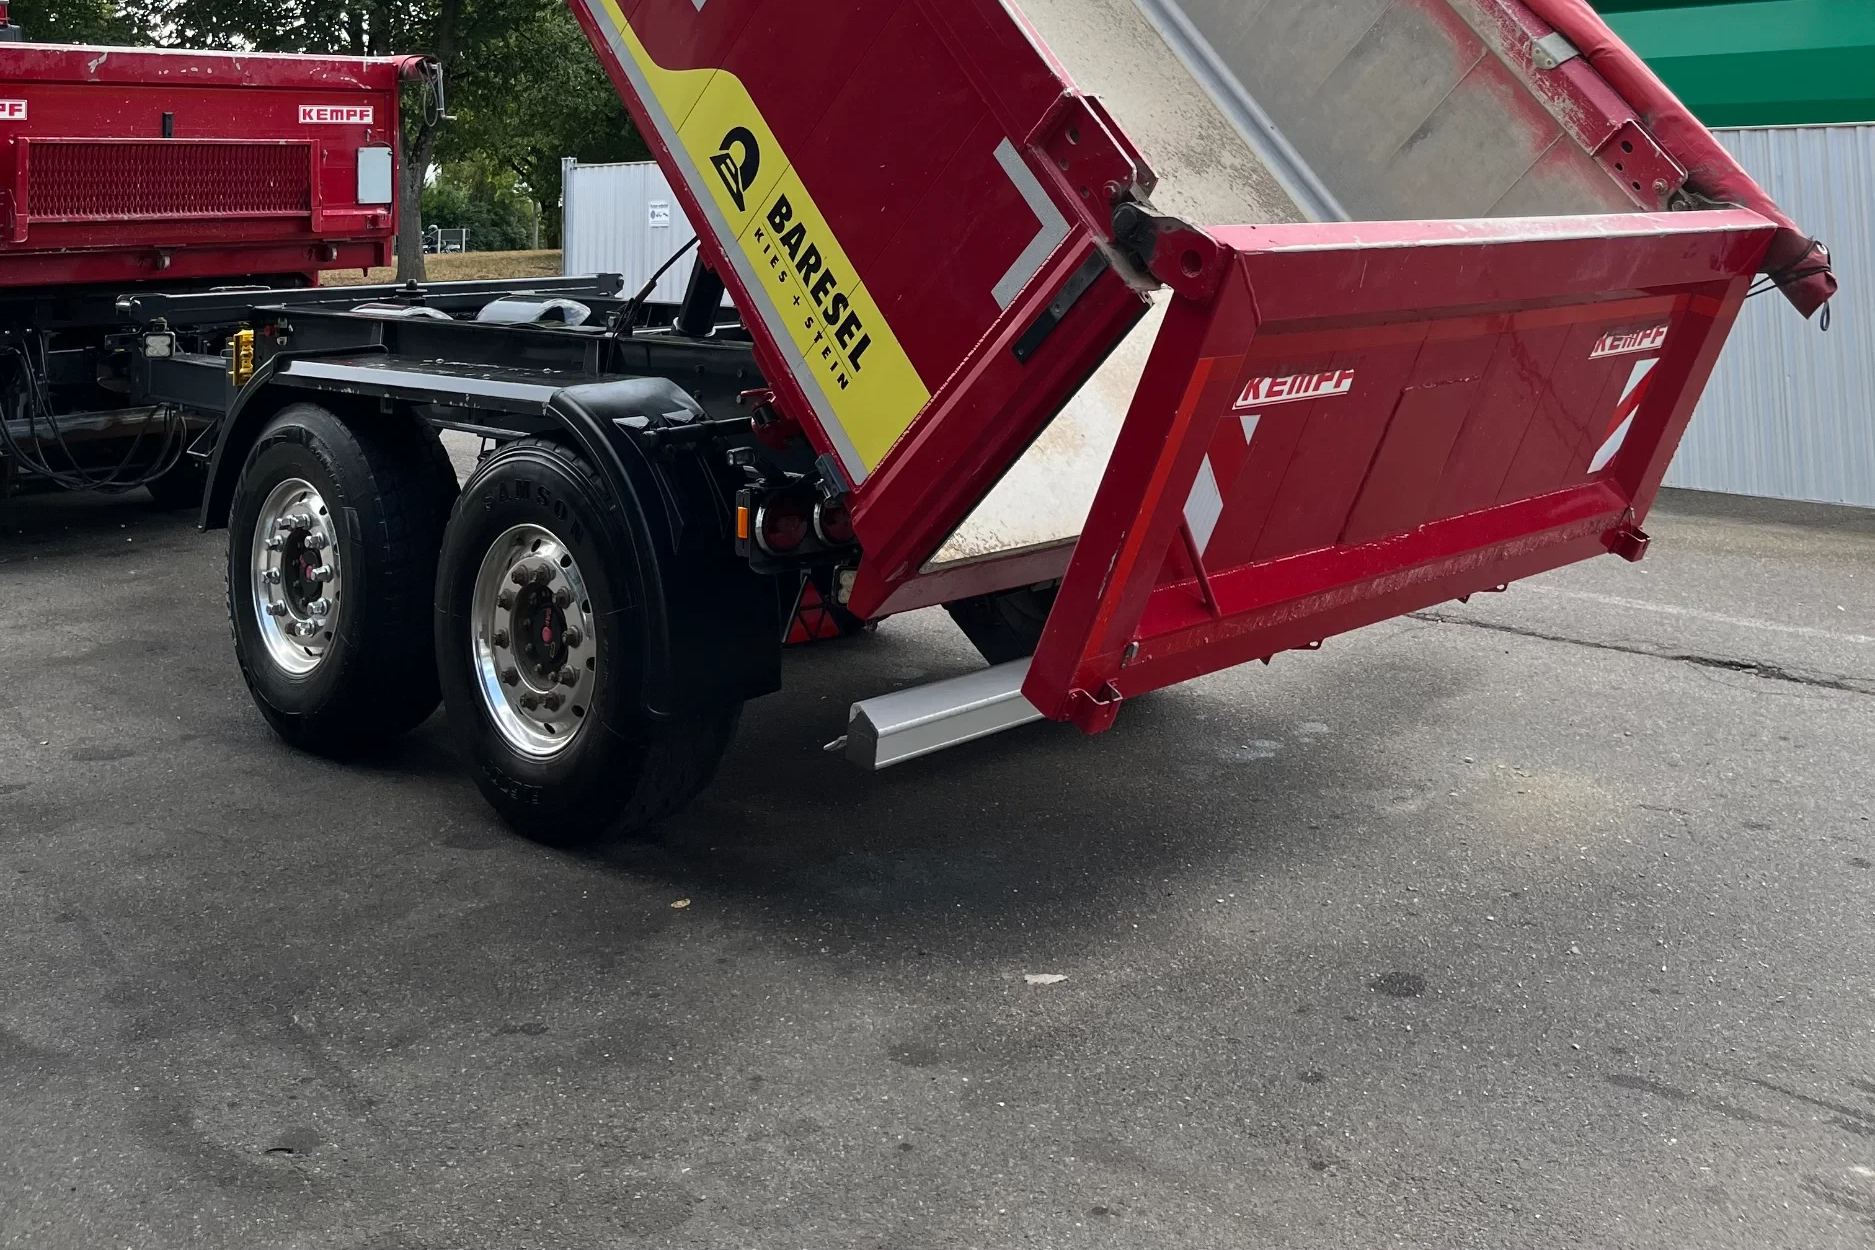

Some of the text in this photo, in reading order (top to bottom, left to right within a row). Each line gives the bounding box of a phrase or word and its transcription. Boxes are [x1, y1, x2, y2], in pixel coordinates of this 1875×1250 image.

[302, 108, 370, 121] KEMPF
[766, 193, 872, 372] BARESEL
[754, 227, 788, 283] KIES
[804, 316, 850, 391] STEIN
[1594, 326, 1666, 354] KEMPF
[1241, 370, 1354, 402] KEMPF
[481, 478, 585, 546] SAMSON
